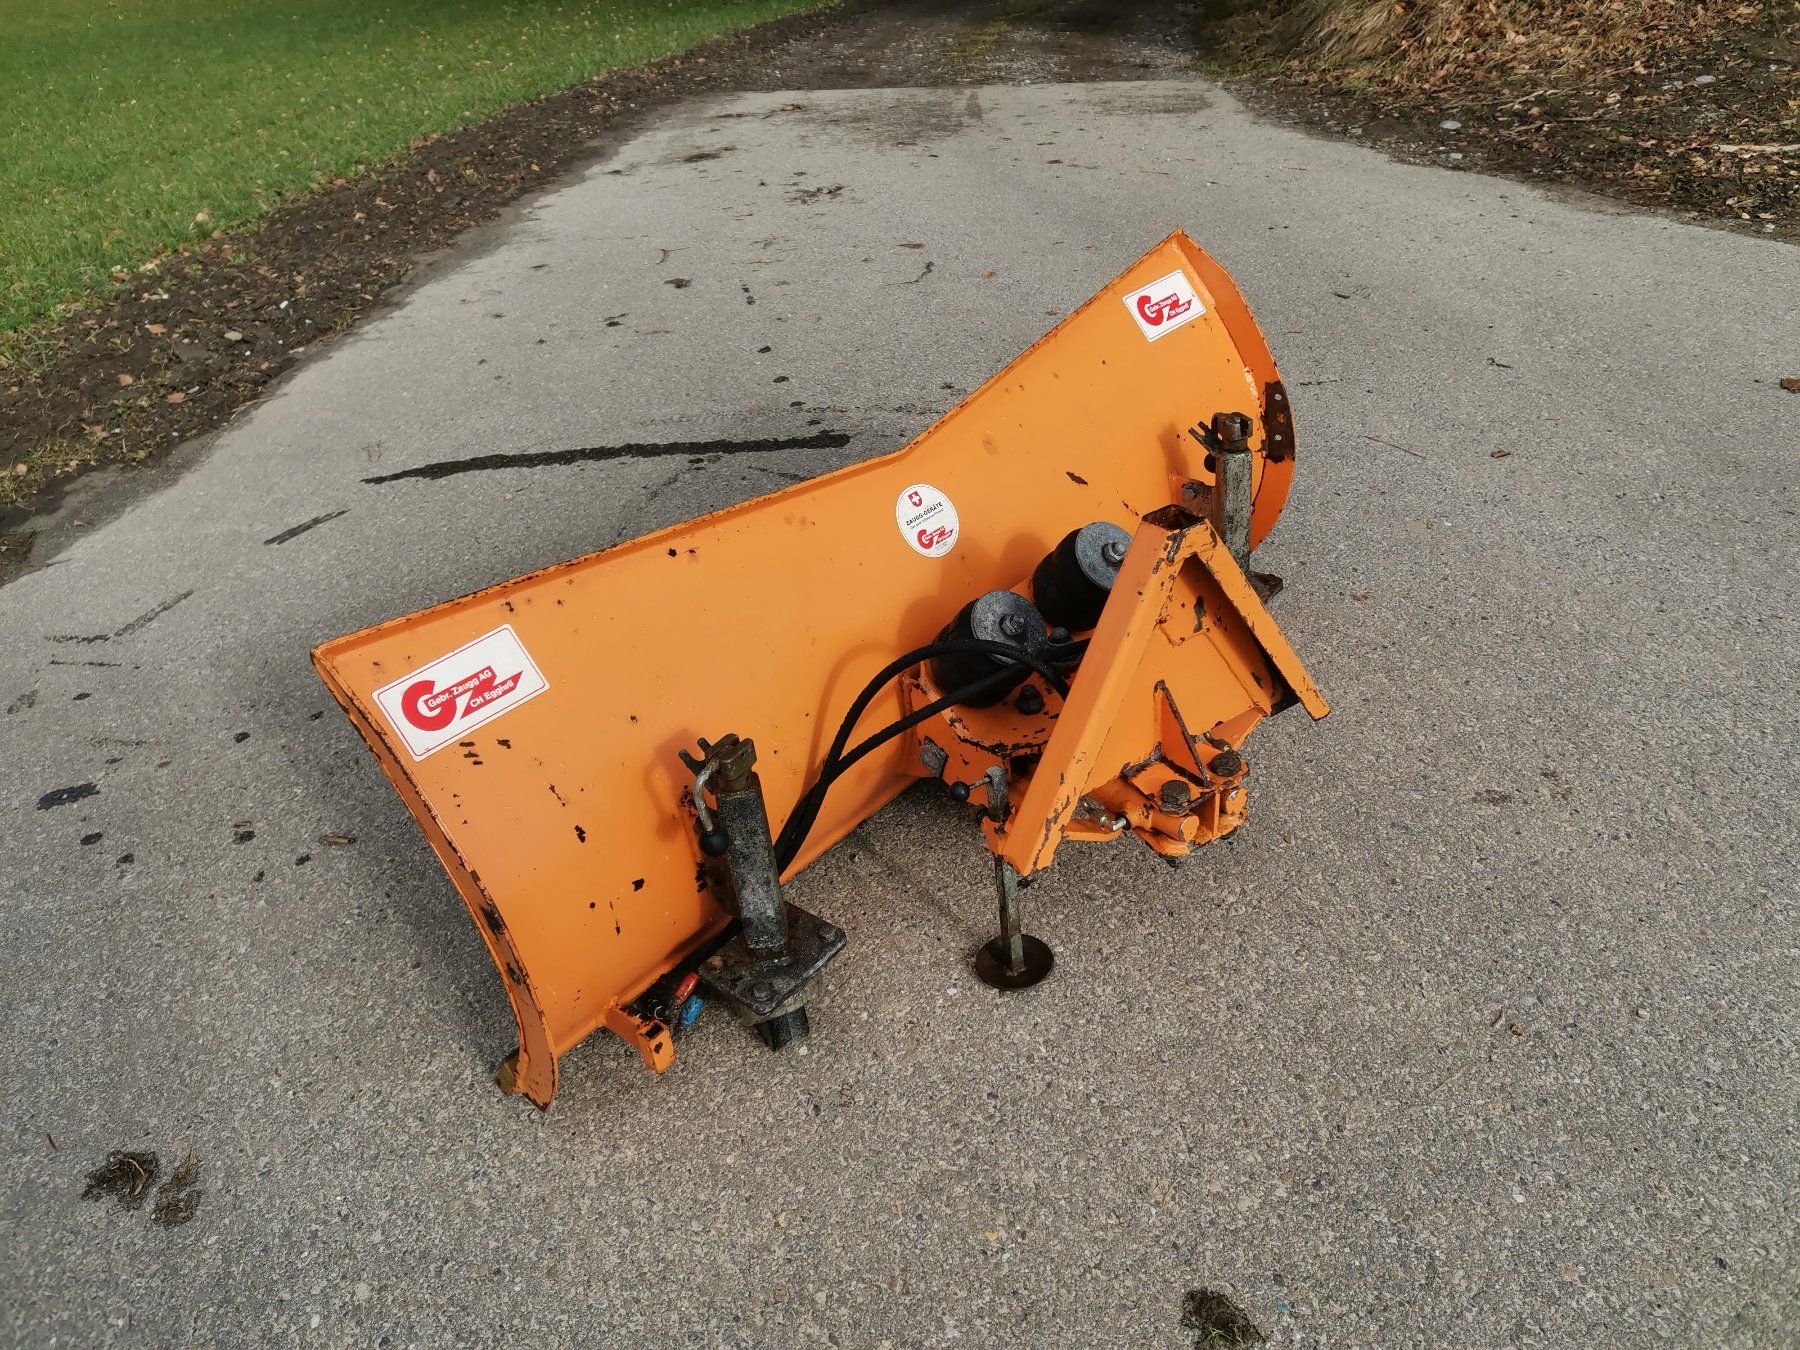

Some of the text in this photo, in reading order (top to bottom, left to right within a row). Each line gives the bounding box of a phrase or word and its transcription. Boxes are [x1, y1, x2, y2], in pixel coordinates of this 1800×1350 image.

[428, 669, 492, 708] Gebr. Zaugg AG
[470, 680, 515, 708] CH Eggiwil
